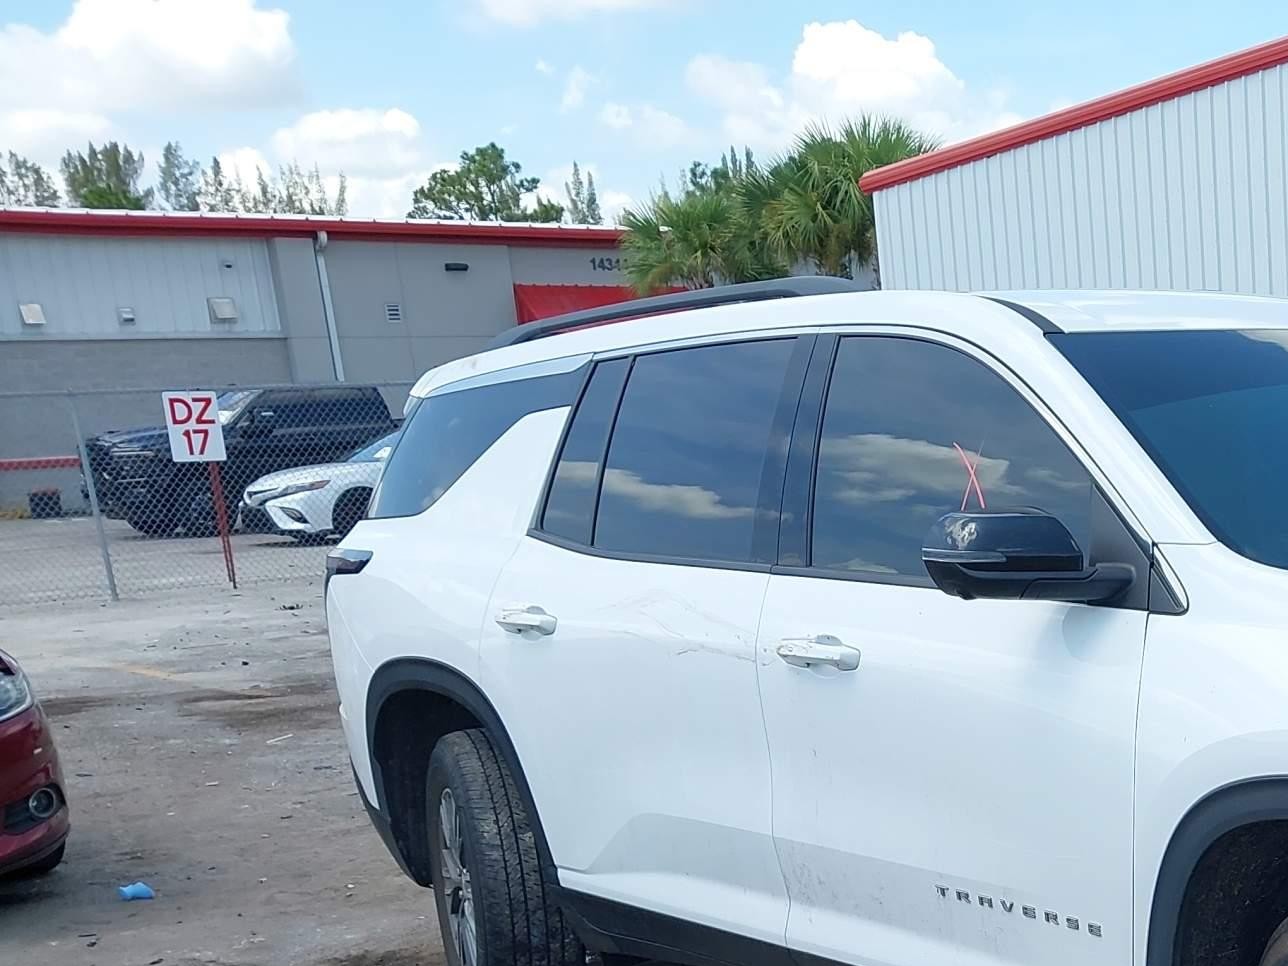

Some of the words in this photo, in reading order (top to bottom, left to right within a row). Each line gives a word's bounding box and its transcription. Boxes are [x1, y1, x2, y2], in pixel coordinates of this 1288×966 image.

[168, 397, 216, 425] DZ
[182, 428, 209, 455] 17
[935, 884, 1102, 937] TRAVERSE
